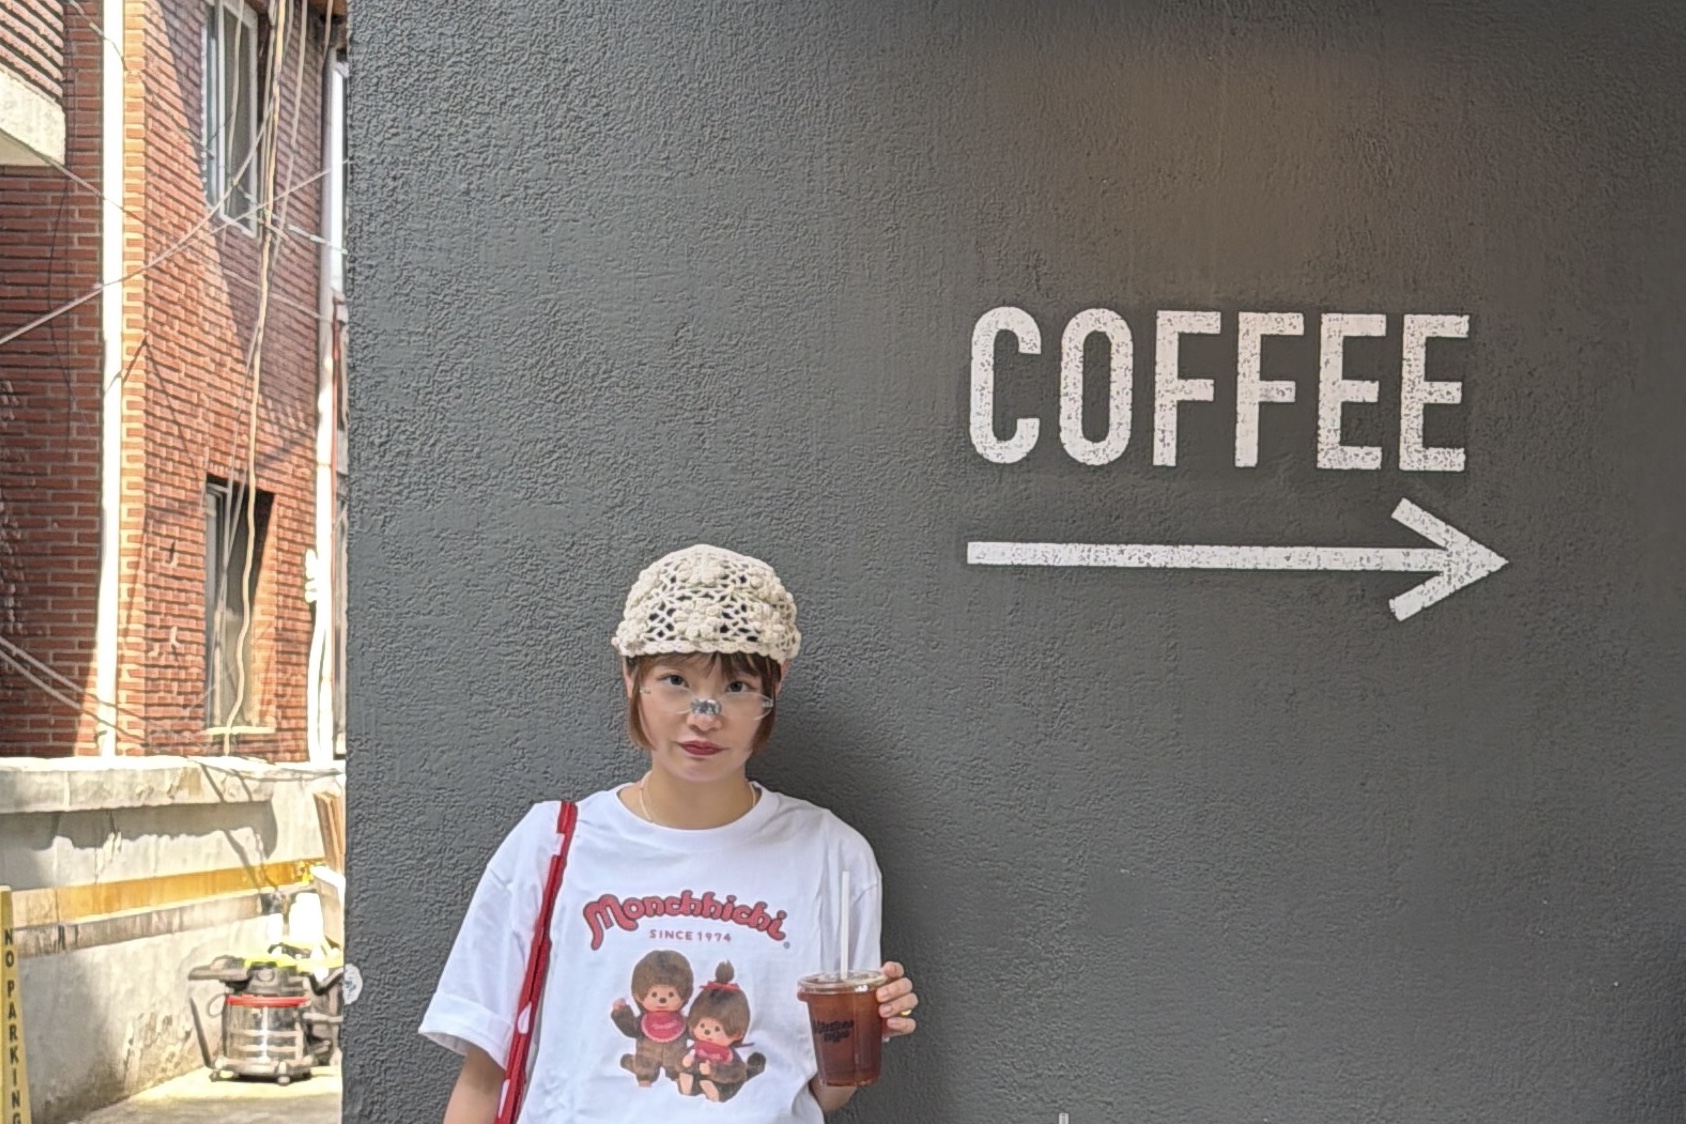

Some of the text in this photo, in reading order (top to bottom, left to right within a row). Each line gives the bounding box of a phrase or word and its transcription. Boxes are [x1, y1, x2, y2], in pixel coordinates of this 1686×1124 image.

[969, 306, 1471, 472] COFFEE
[583, 889, 788, 950] Monchhichi
[649, 929, 732, 942] SINCE 1974
[4, 928, 15, 968] NO
